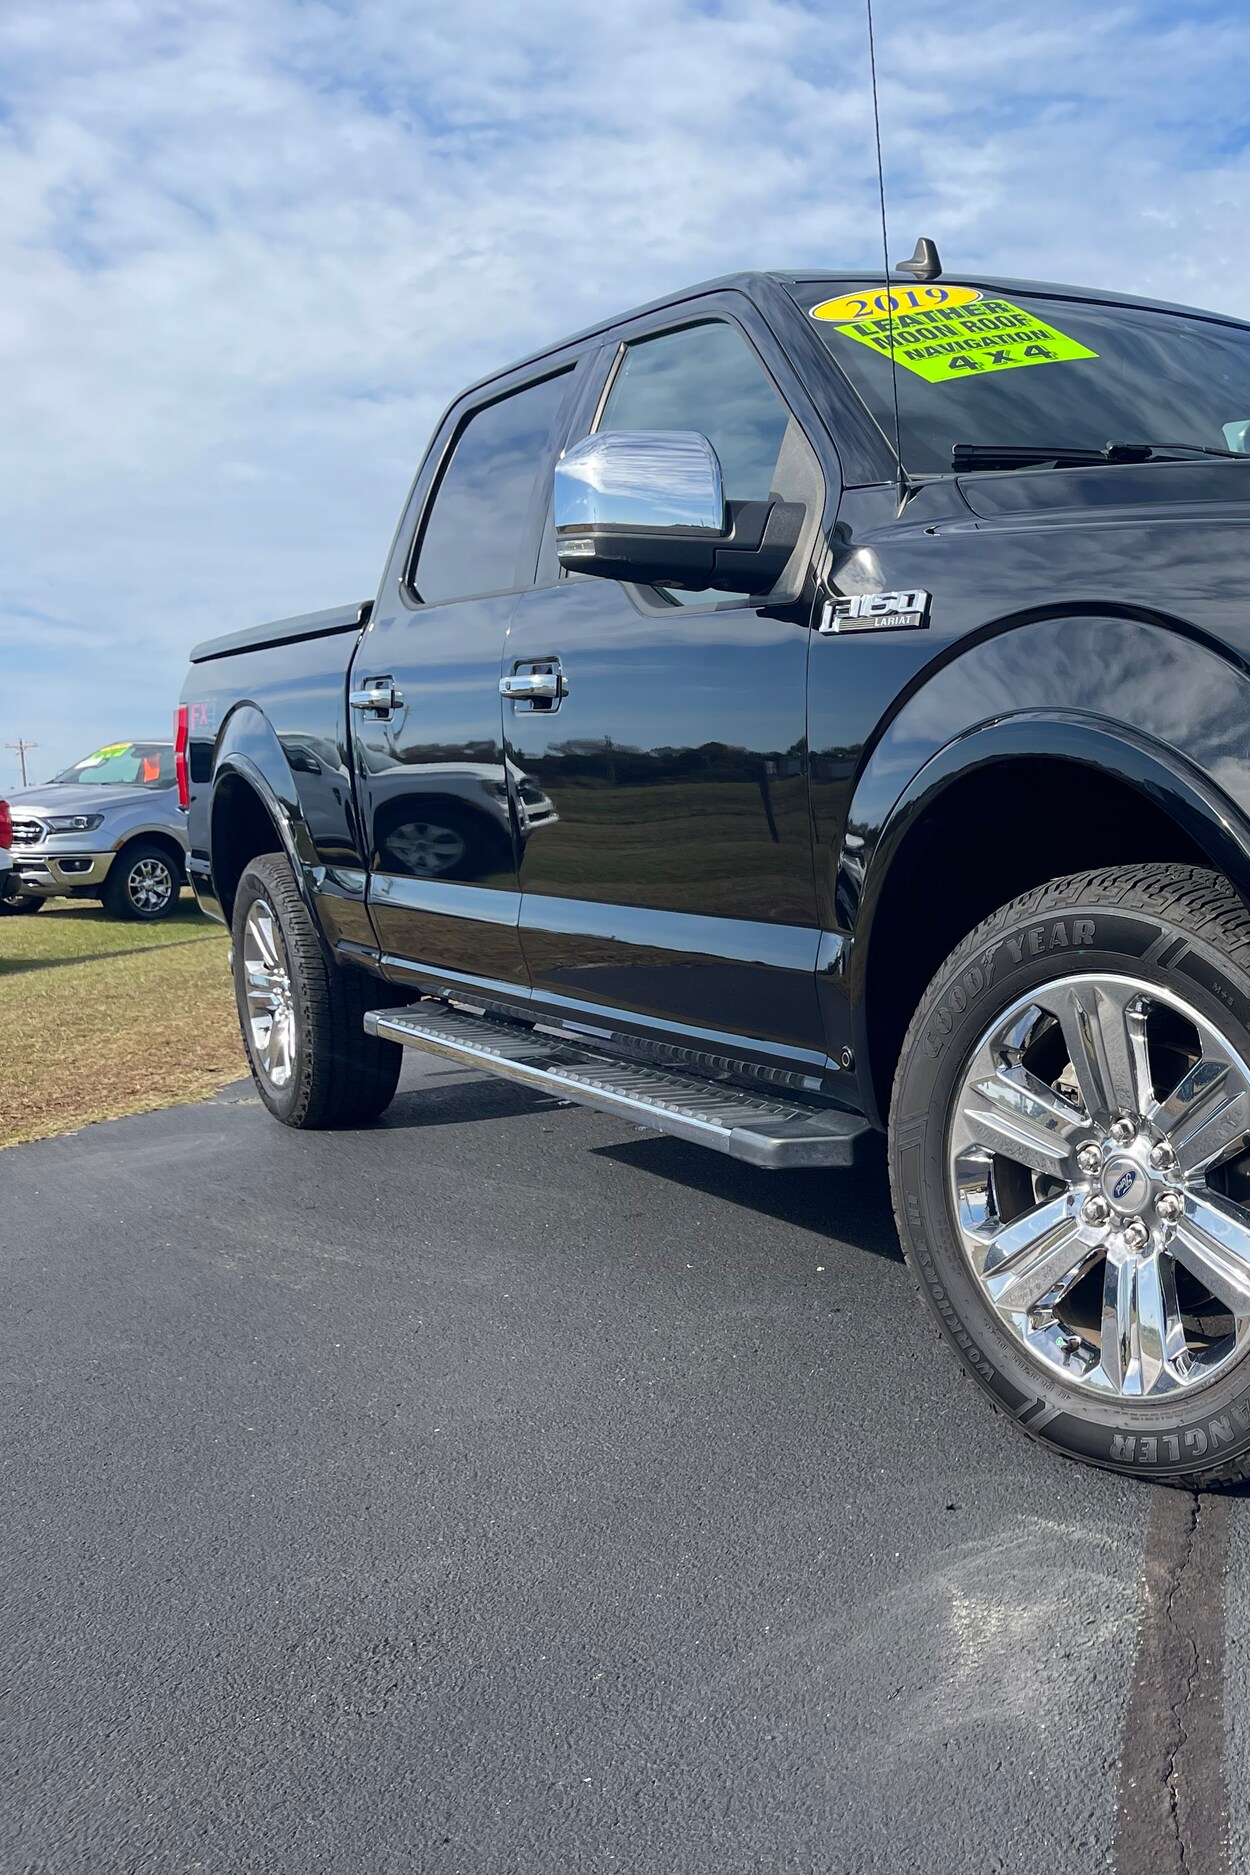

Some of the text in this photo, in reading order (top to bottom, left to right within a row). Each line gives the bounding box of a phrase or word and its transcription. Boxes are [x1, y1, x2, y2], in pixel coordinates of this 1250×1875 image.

[846, 288, 949, 318] 2019
[852, 302, 1012, 337] LEATHER
[871, 314, 1028, 350] MOON ROOF
[903, 330, 1050, 361] NAVIGATION
[874, 615, 912, 627] LARIAT
[1115, 1173, 1132, 1197] Ford
